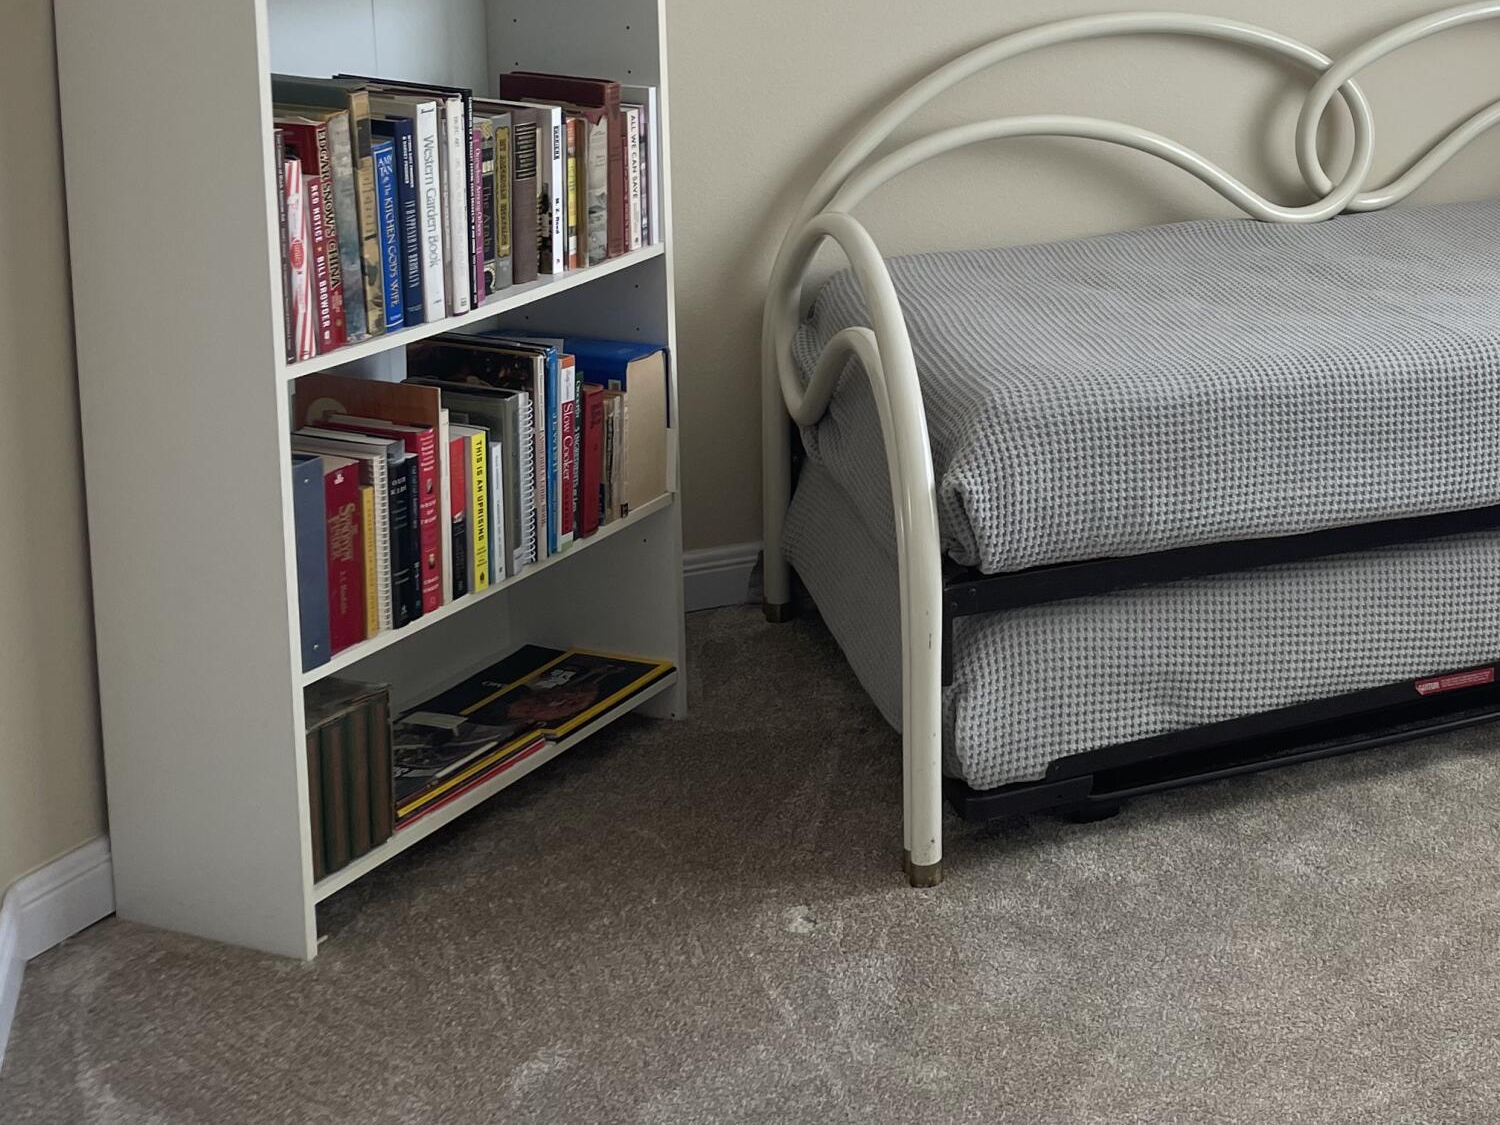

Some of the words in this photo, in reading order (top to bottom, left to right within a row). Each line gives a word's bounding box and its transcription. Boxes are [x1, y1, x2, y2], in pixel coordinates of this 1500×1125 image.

[318, 126, 330, 182] EDGAR
[631, 134, 637, 149] WE
[423, 135, 435, 185] Western
[310, 185, 320, 204] RED
[322, 183, 336, 238] SNOW'S
[426, 187, 437, 233] Garden
[313, 207, 323, 243] NOTICE
[384, 197, 396, 244] KITCHEN
[317, 256, 327, 278] BILL
[327, 240, 341, 290] CHINA
[387, 246, 398, 278] GOD'S
[428, 236, 438, 268] Book
[319, 280, 331, 328] BROWDER
[390, 278, 400, 308] WIFE
[563, 403, 574, 432] Slow
[475, 441, 483, 464] THIS
[562, 436, 573, 480] Cooker
[476, 466, 483, 476] IS
[477, 479, 483, 493] AN
